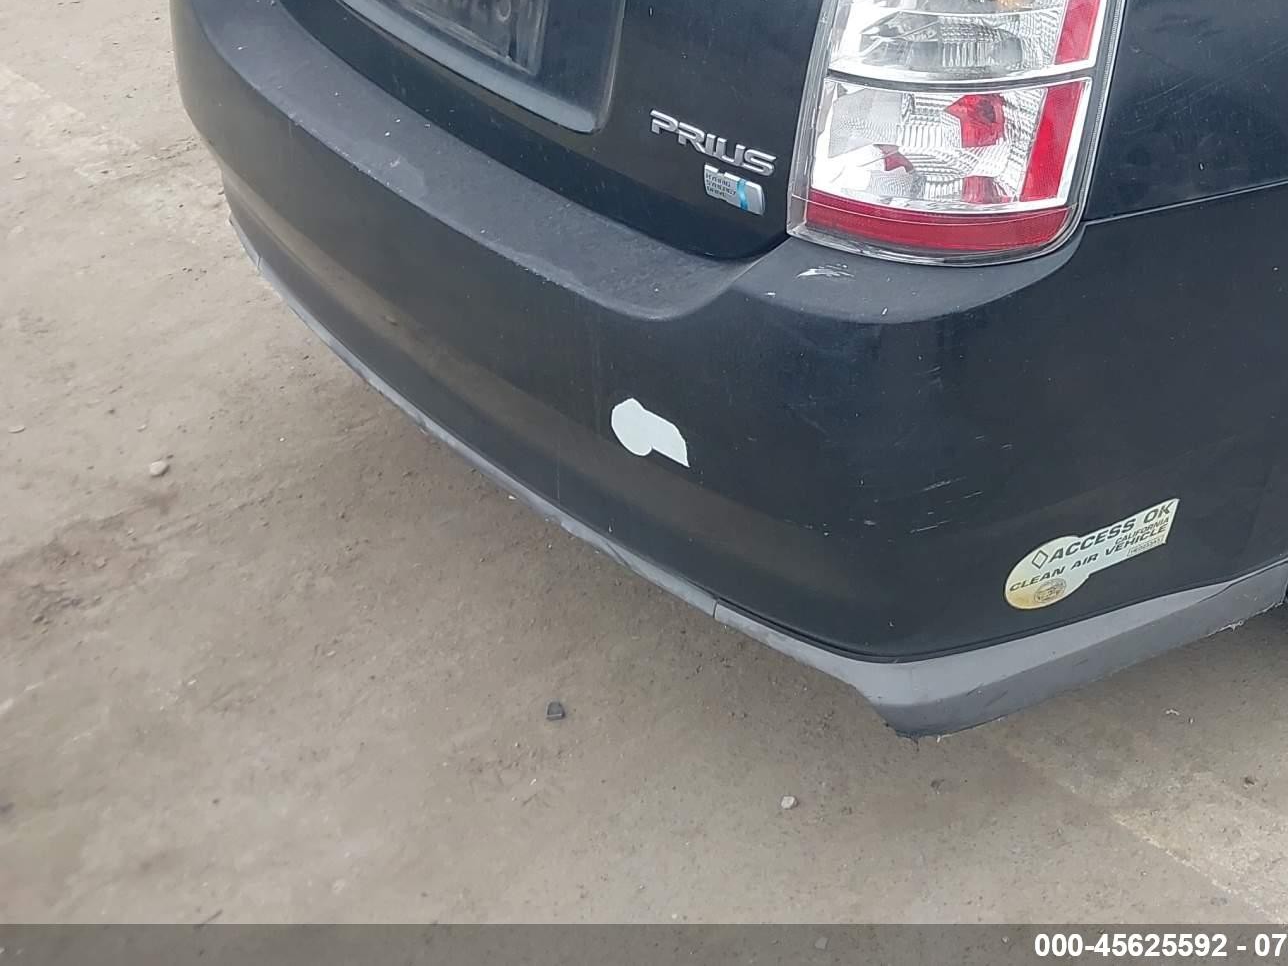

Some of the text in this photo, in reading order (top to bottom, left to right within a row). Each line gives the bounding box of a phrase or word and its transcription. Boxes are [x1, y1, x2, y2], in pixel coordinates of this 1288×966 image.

[650, 109, 777, 177] PRIUS
[1009, 565, 1066, 592] CLEAN
[1070, 552, 1099, 571] AIR
[1105, 524, 1168, 556] VEHICLE
[1049, 518, 1137, 563] ACCESS
[1143, 501, 1174, 524] OK
